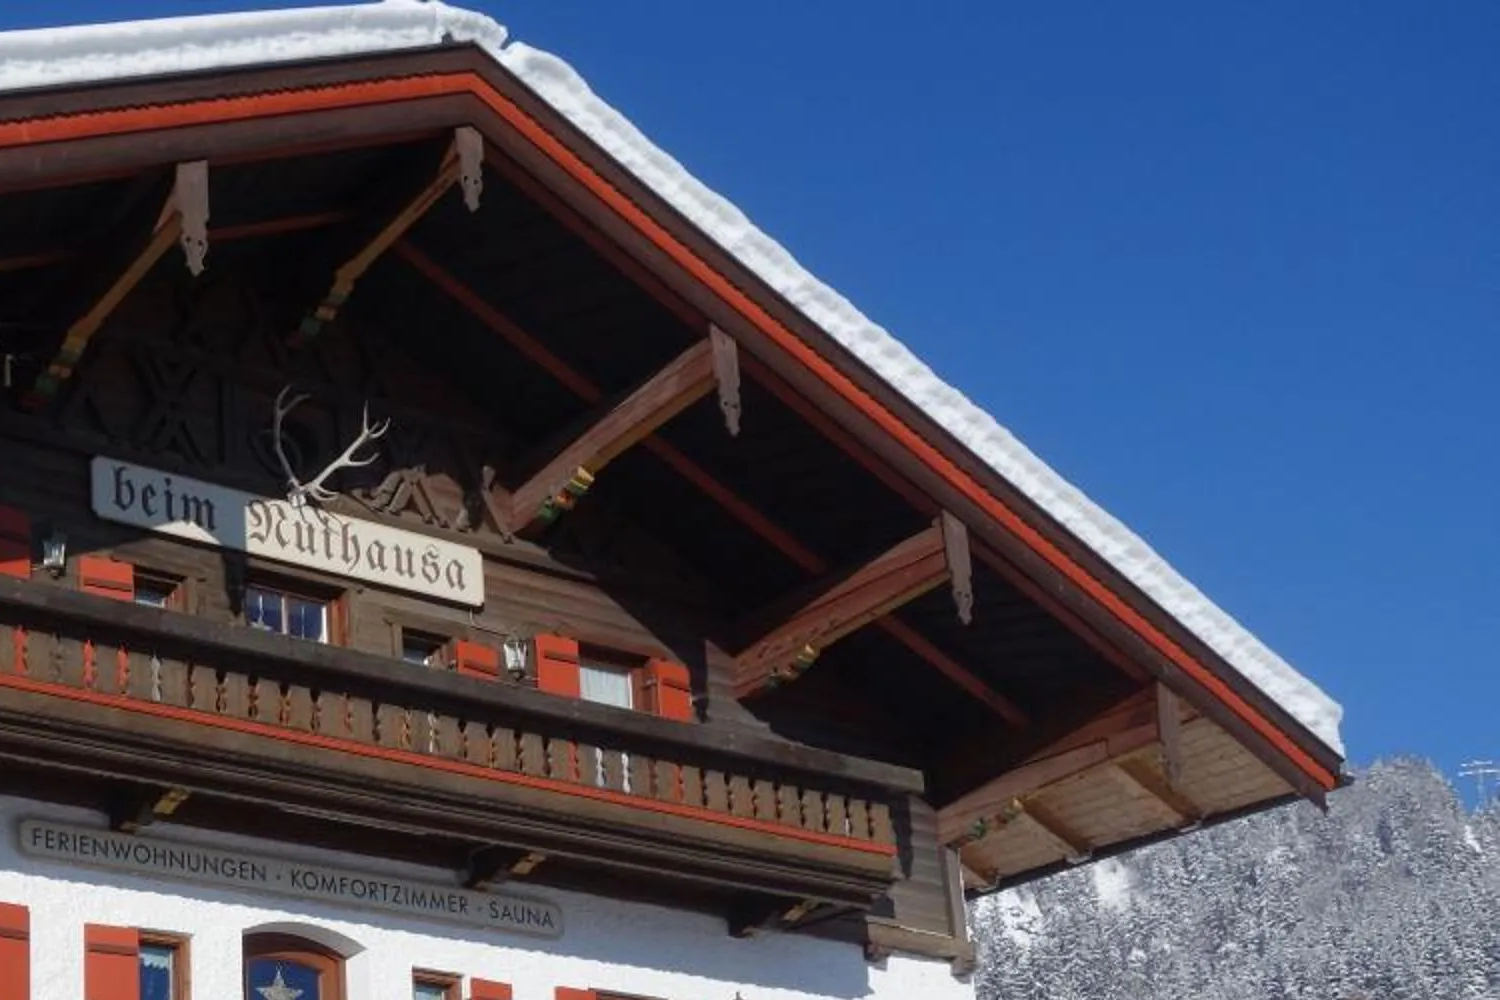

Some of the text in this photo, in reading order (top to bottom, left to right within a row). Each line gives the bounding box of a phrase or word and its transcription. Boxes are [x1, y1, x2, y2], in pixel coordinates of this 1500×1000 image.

[112, 464, 217, 532] beim
[31, 826, 555, 929] FERIENWOHNUNGEN KOMFORTZIMMER SAUNA
